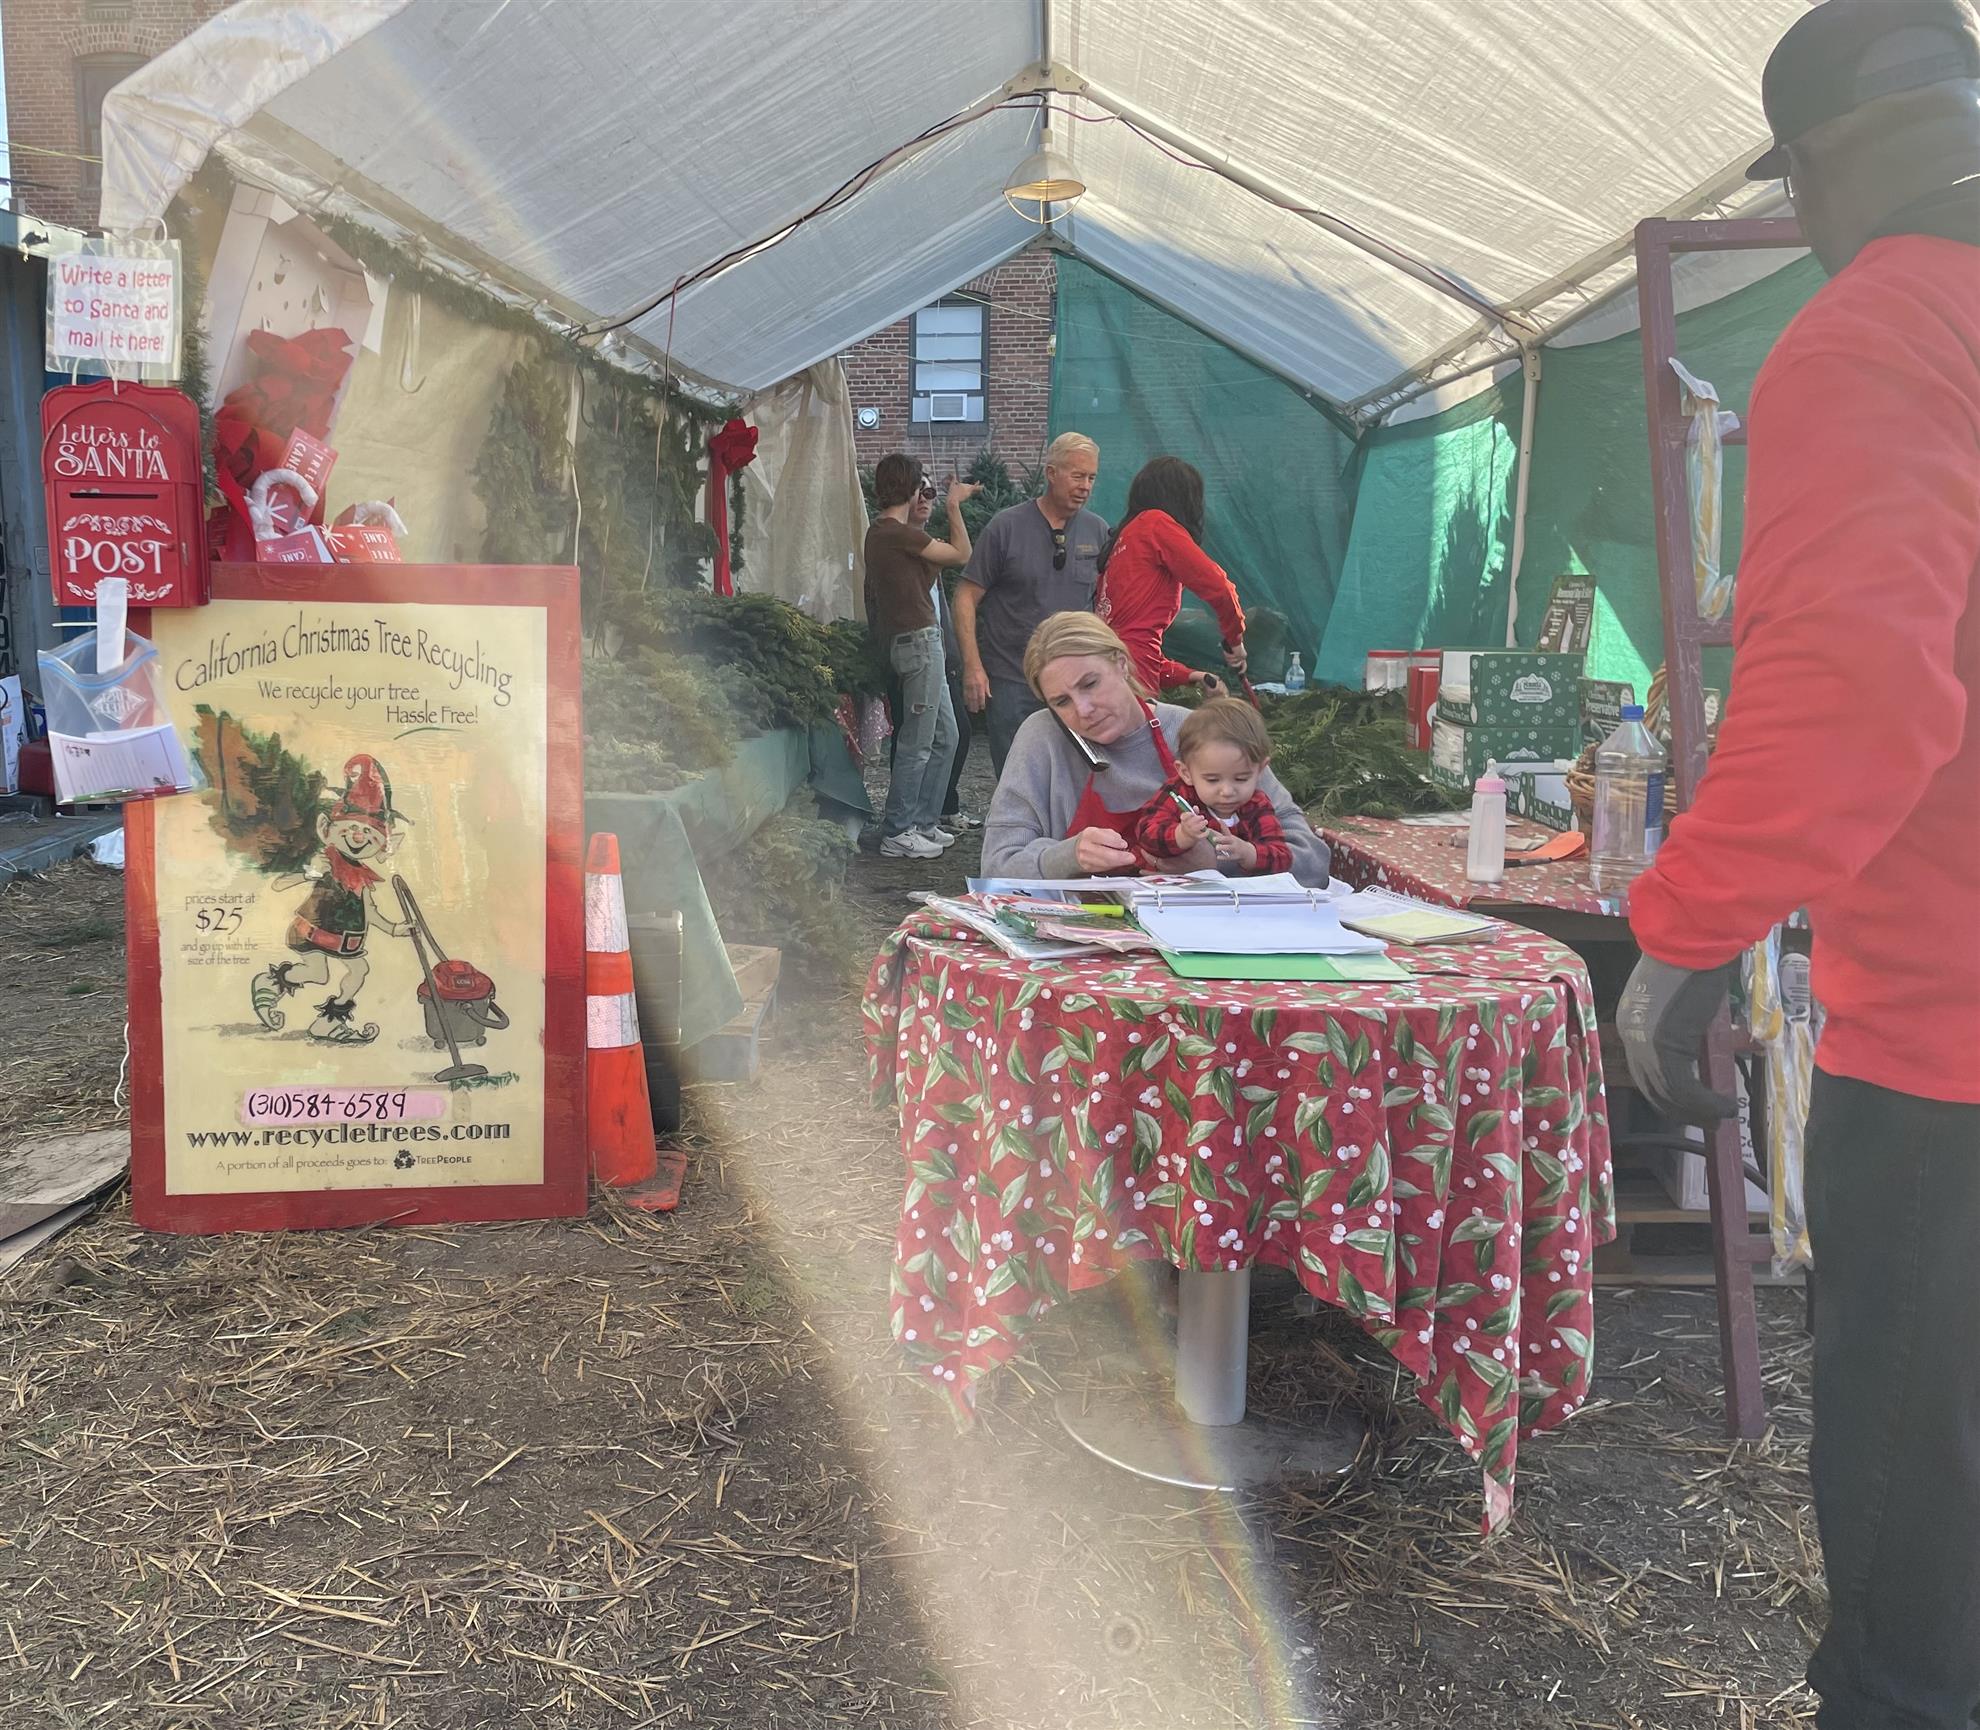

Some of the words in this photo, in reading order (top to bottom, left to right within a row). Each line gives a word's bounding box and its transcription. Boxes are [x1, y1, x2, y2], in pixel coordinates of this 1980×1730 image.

[61, 264, 112, 286] Write
[117, 272, 126, 287] a
[133, 270, 171, 288] letter
[64, 298, 84, 313] to
[90, 298, 139, 320] Santa
[144, 302, 168, 320] and
[68, 330, 103, 347] mail
[110, 330, 124, 348] it
[128, 332, 164, 351] here!
[59, 423, 131, 447] Letters
[138, 428, 161, 449] to
[54, 444, 169, 480] SANTA
[64, 536, 168, 574] POST
[175, 630, 277, 691] California
[283, 610, 370, 658] Christmas
[374, 619, 412, 658] Tree
[417, 628, 513, 707] Recycling
[258, 680, 282, 699] We
[286, 675, 343, 710] recycle
[346, 686, 385, 710] your
[388, 683, 420, 701] tree
[386, 699, 438, 724] Hassle
[441, 705, 478, 724] Free!
[185, 895, 216, 911] prices
[218, 893, 244, 904] start
[245, 892, 256, 904] at
[195, 907, 243, 935] $25
[180, 937, 198, 951] and
[199, 943, 211, 956] go
[212, 943, 224, 953] up
[225, 936, 243, 950] with
[244, 937, 258, 950] the
[187, 955, 204, 966] size
[205, 951, 216, 965] of
[217, 951, 231, 965] the
[232, 955, 250, 965] tree
[248, 1092, 406, 1119] (310)584-6589
[186, 1121, 510, 1148] www.recycletrees.com
[216, 1160, 225, 1170] A
[227, 1158, 267, 1176] portion
[268, 1156, 279, 1169] of
[282, 1156, 293, 1169] all
[296, 1154, 345, 1173] proceeds
[346, 1158, 371, 1171] goes
